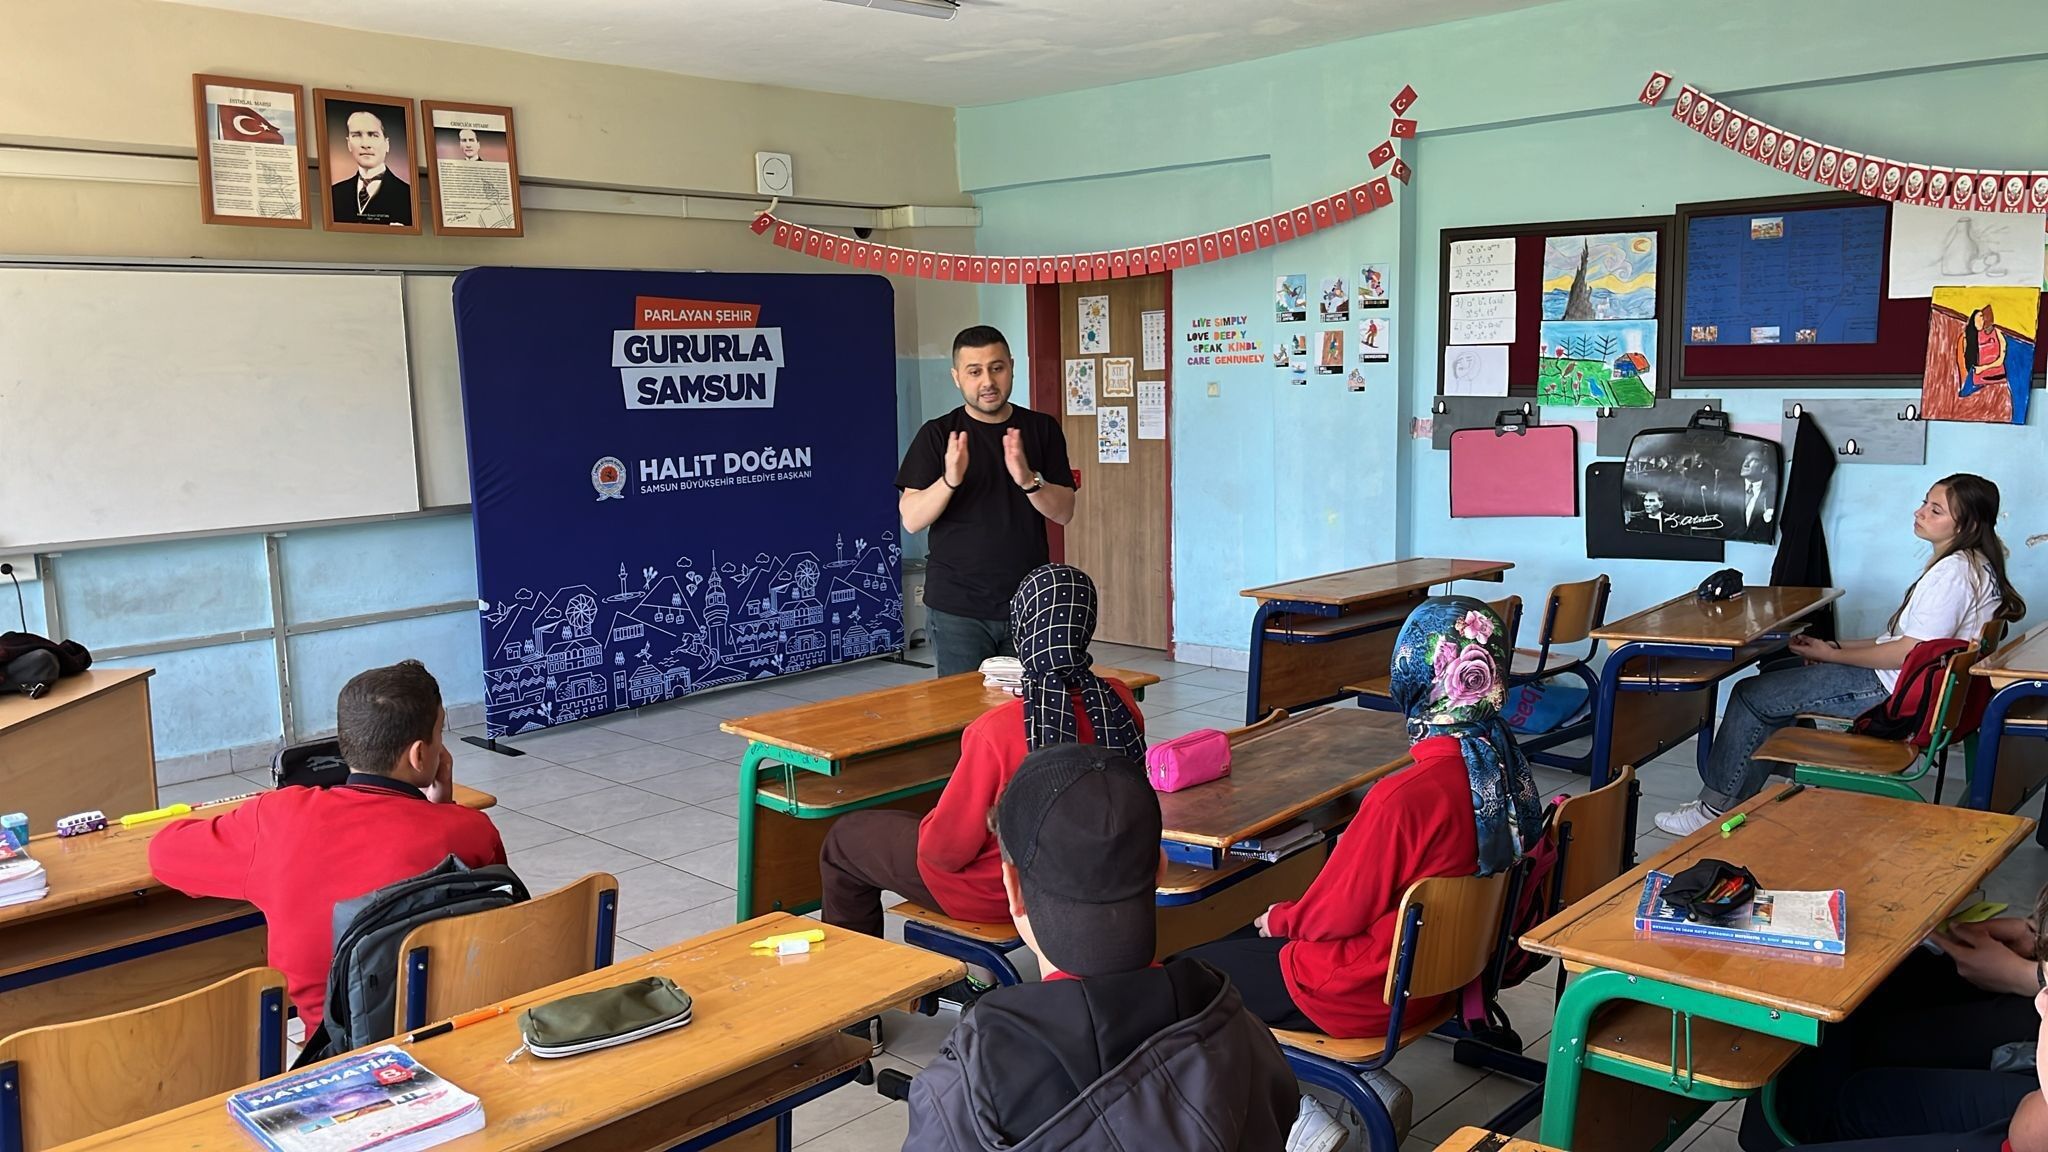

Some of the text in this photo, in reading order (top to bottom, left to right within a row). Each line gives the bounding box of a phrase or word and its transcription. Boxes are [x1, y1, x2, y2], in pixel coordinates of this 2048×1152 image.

[644, 310, 752, 324] PARLAYAN ŞEHİR
[1192, 318, 1211, 328] LIVE
[1187, 332, 1209, 341] LOVE
[623, 334, 773, 364] GURURLA
[1193, 343, 1223, 353] SPEAK
[1187, 356, 1210, 365] CARE
[637, 372, 766, 405] SAMSUN
[724, 446, 812, 472] DOĞAN
[640, 470, 812, 494] SAMSUN BÜYÜKŞEHİR BELEDİYE BAŞKANI
[380, 1067, 406, 1080] 8.
[250, 1054, 398, 1108] MATEMATİK
